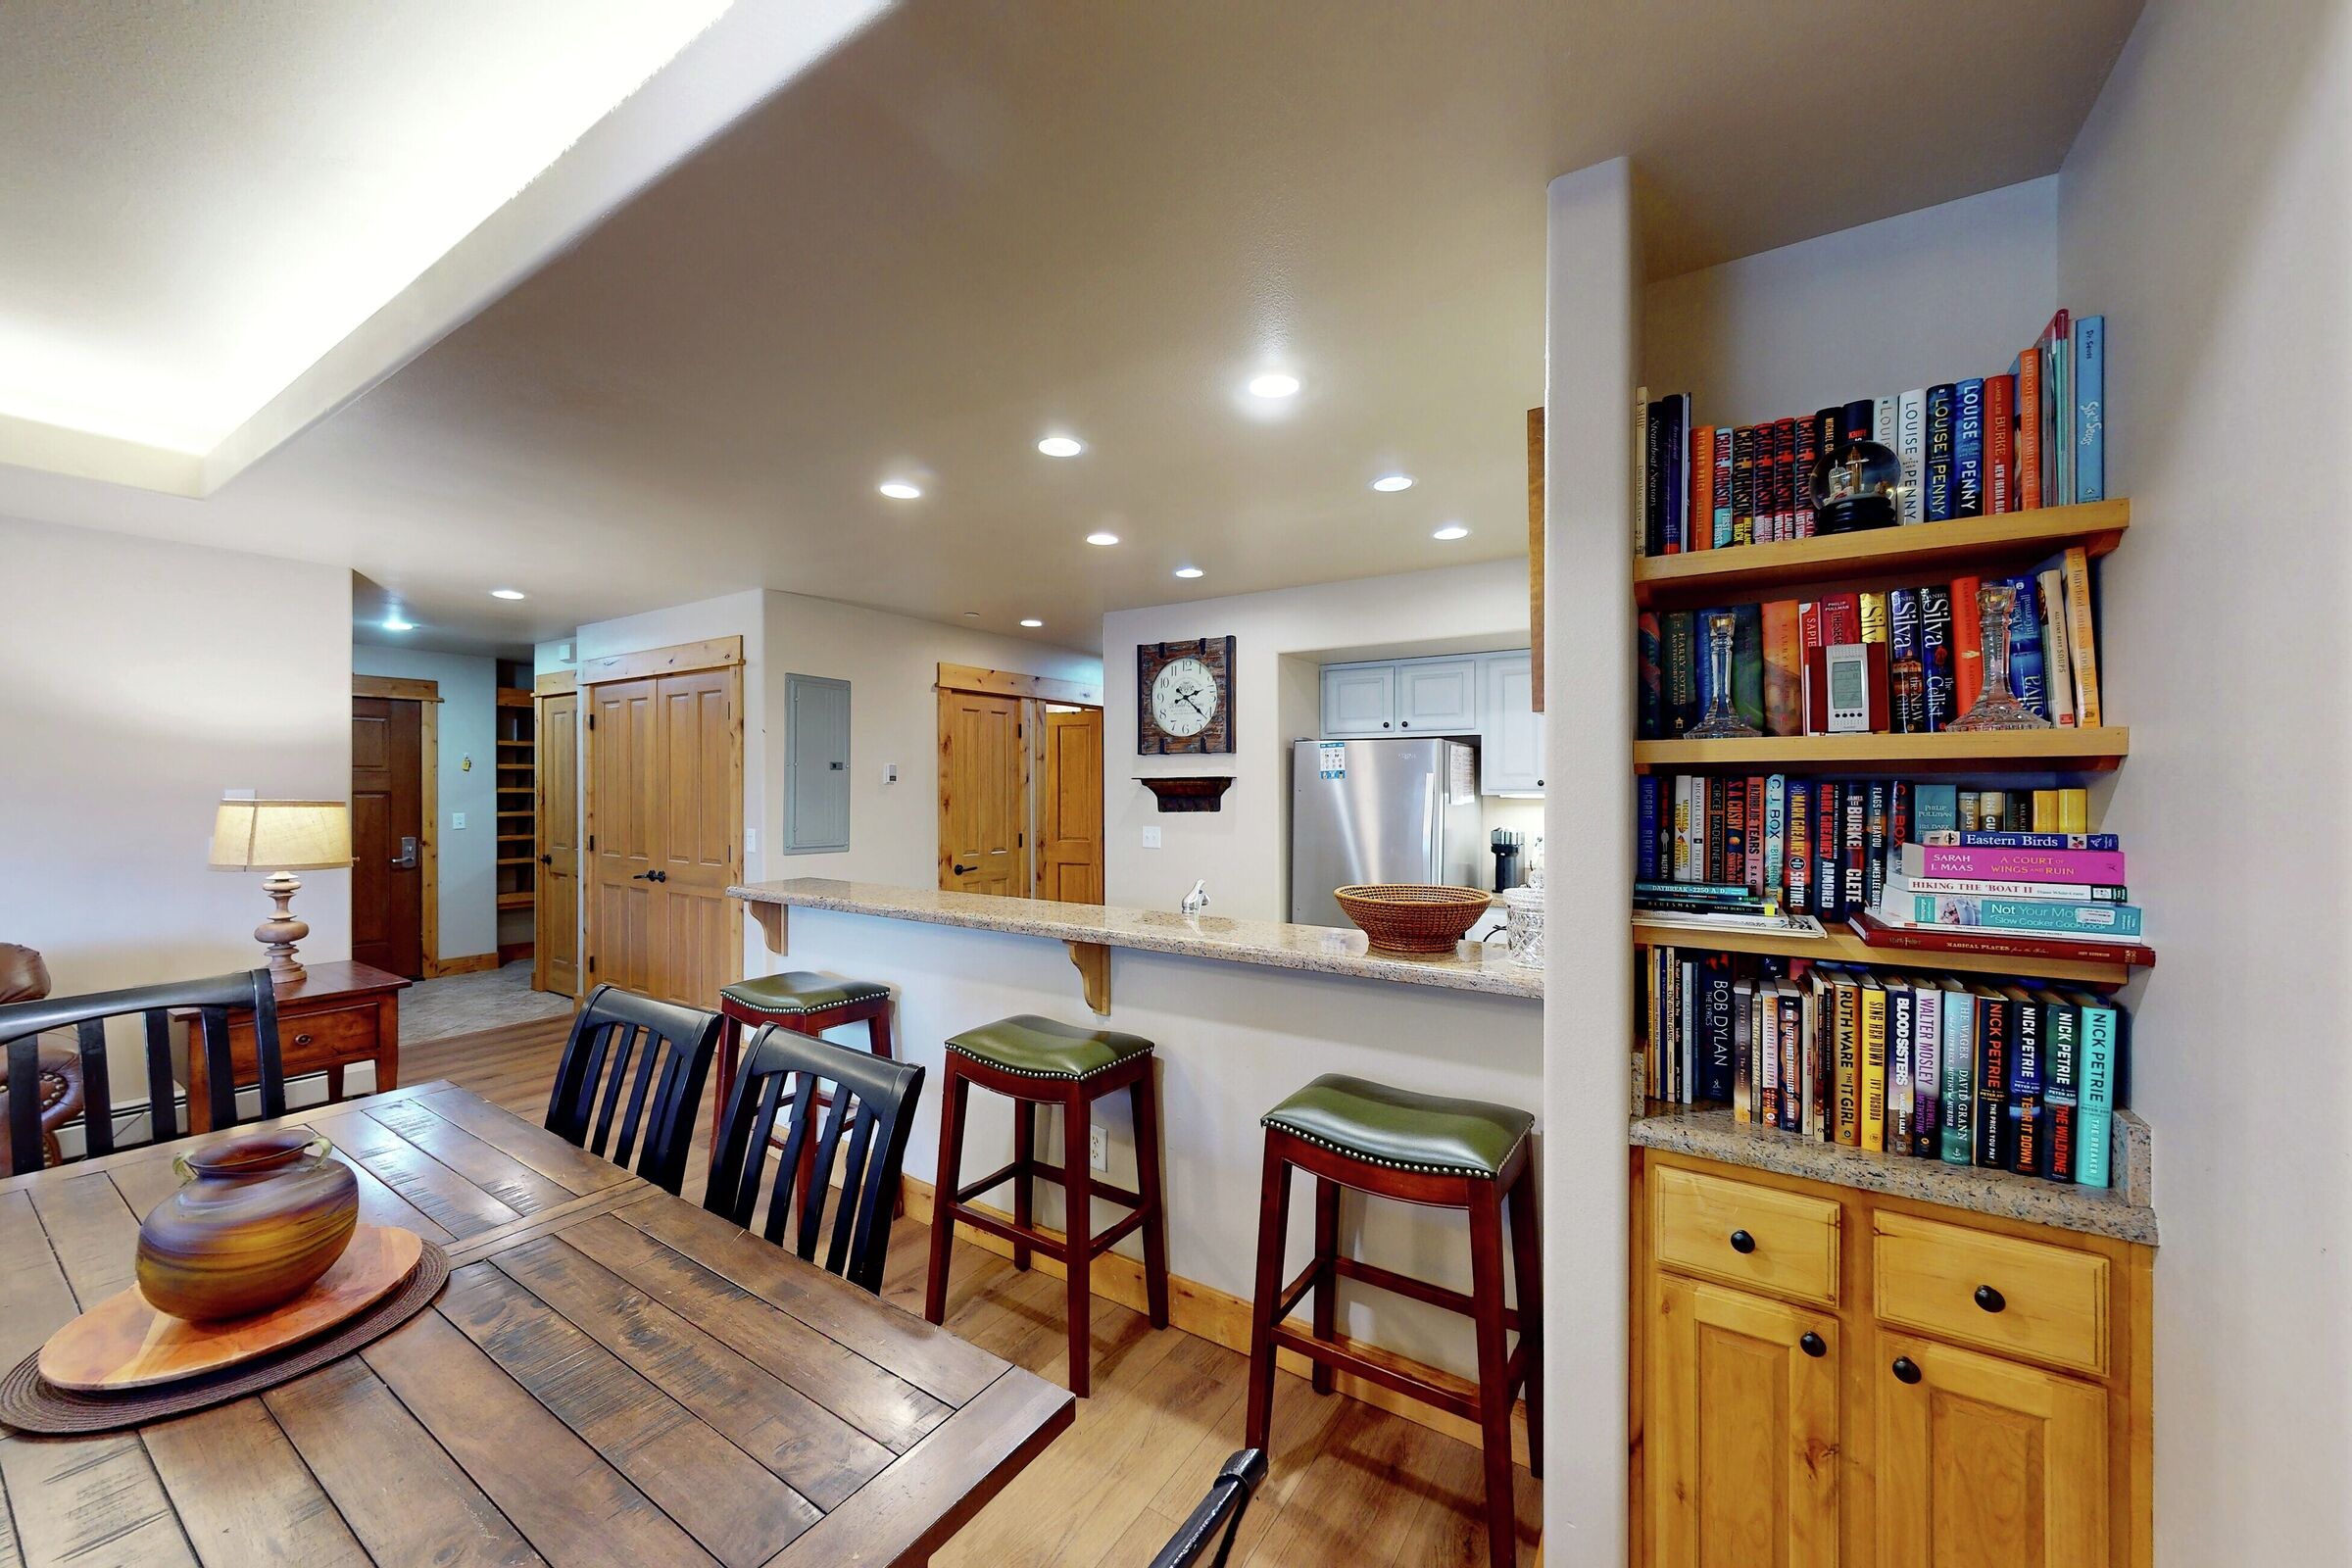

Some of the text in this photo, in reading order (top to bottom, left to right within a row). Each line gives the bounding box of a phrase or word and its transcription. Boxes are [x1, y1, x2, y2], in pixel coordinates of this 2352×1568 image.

[1935, 398, 1949, 454] LOUISE
[1963, 385, 1979, 439] LOUISE
[2025, 356, 2035, 488] BAREFOOT CONTESSA FAMILY STYLE
[2081, 401, 2102, 445] Six Seuss
[1650, 417, 1661, 467] Steamboat
[1755, 426, 1773, 462] CRAIG
[1994, 416, 2006, 456] BURKE
[1715, 433, 1732, 509] CRAIG JOHNSON
[1734, 430, 1752, 516] CRAIG JOHNSON
[1775, 421, 1793, 512] CRAIG JOHNSON
[1795, 420, 1815, 513] CRAIG JOHNSON
[1904, 402, 1918, 519] LOUISE PENNY
[1650, 469, 1661, 507] Seasons
[1755, 461, 1773, 517] JOHNSON
[1932, 465, 1946, 514] PENNY
[1961, 461, 1977, 509] PENNY
[1714, 524, 1723, 545] FROST
[1722, 514, 1731, 530] FIRST
[1892, 601, 1918, 651] Silva
[1924, 599, 1950, 649] Silva
[1182, 660, 1193, 672] 12
[1199, 662, 1202, 675] 1
[1678, 632, 1687, 667] HARRY
[1160, 677, 1170, 689] 10
[1170, 665, 1177, 677] 11
[1943, 676, 1954, 691] The
[1156, 692, 1165, 704] 9
[1158, 708, 1167, 720] 8
[1926, 675, 1945, 718] Cellist
[1170, 719, 1178, 731] 7
[1181, 724, 1190, 735] 6
[1694, 783, 1703, 811] MICHAEL
[1712, 784, 1722, 809] CIRCE
[1726, 801, 1743, 831] COSBY
[1872, 787, 1883, 848] FLAGS BAYOU
[1918, 810, 1952, 819] PULLMAN
[1642, 784, 1653, 854] UPGRADE BLAKE
[1711, 815, 1722, 860] MADELINE
[1748, 784, 1761, 855] RAZORBLADE TEARS
[1769, 809, 1781, 840] BOX
[1789, 795, 1806, 858] MARK GREANEY
[1819, 784, 1834, 859] MARK GREANEY
[1846, 806, 1863, 847] BURKE
[1933, 854, 1971, 865] SARAH
[1966, 834, 2059, 849] Eastern Birds
[2000, 856, 2008, 865] A
[1789, 871, 1805, 907] SENTINEL
[1821, 860, 1836, 908] ARMORED
[1845, 868, 1862, 903] CLETE
[1872, 858, 1881, 910] JAMES LEE BURKE
[1913, 881, 1954, 891] HIKING
[1959, 883, 1980, 892] THE
[1984, 884, 2017, 893] 'BOAT
[1940, 864, 1975, 873] MAAS
[1990, 865, 2029, 875] WINGS
[1647, 901, 1696, 909] BLUESMAN
[1990, 904, 2016, 916] Not
[2018, 906, 2048, 918] Your
[1993, 914, 2017, 926] Slow
[2018, 918, 2054, 928] Cooker
[2055, 921, 2107, 931] Cookbook
[1946, 941, 2010, 952] MAGICAL PLACES
[1713, 980, 1729, 1066] BOB DYLAN
[1739, 1004, 1747, 1024] PETER
[1839, 990, 1854, 1068] RUTH WARE
[1868, 1002, 1884, 1067] SING HER DOWN
[1960, 1001, 1970, 1060] THE WAGER
[2092, 1013, 2107, 1048] NICK
[1766, 1001, 1776, 1087] THE BEEKEEPER OF ALEPPO
[1894, 998, 1910, 1086] BLOOD SISTERS
[1918, 998, 1936, 1085] WALTER MOSLEY
[1987, 1004, 2002, 1089] NICK PETRIE
[2021, 1006, 2036, 1078] NICK PETRIE
[2056, 1012, 2073, 1085] NICK PETRIE
[1740, 1068, 1748, 1089] Painter
[1840, 1083, 1854, 1096] IT
[2089, 1052, 2105, 1102] PETRIE
[1840, 1097, 1854, 1126] GIRL
[1869, 1078, 1882, 1121] IVY POCHODA
[1898, 1093, 1907, 1135] VANESSA LILLIE
[1926, 1096, 1936, 1132] FAREWELL,
[1957, 1069, 1969, 1142] DAVID GRANN
[2020, 1096, 2034, 1164] TEAR IT DOWN
[2053, 1104, 2069, 1173] THE WILD ONE
[2089, 1118, 2100, 1175] THE BREAKER
